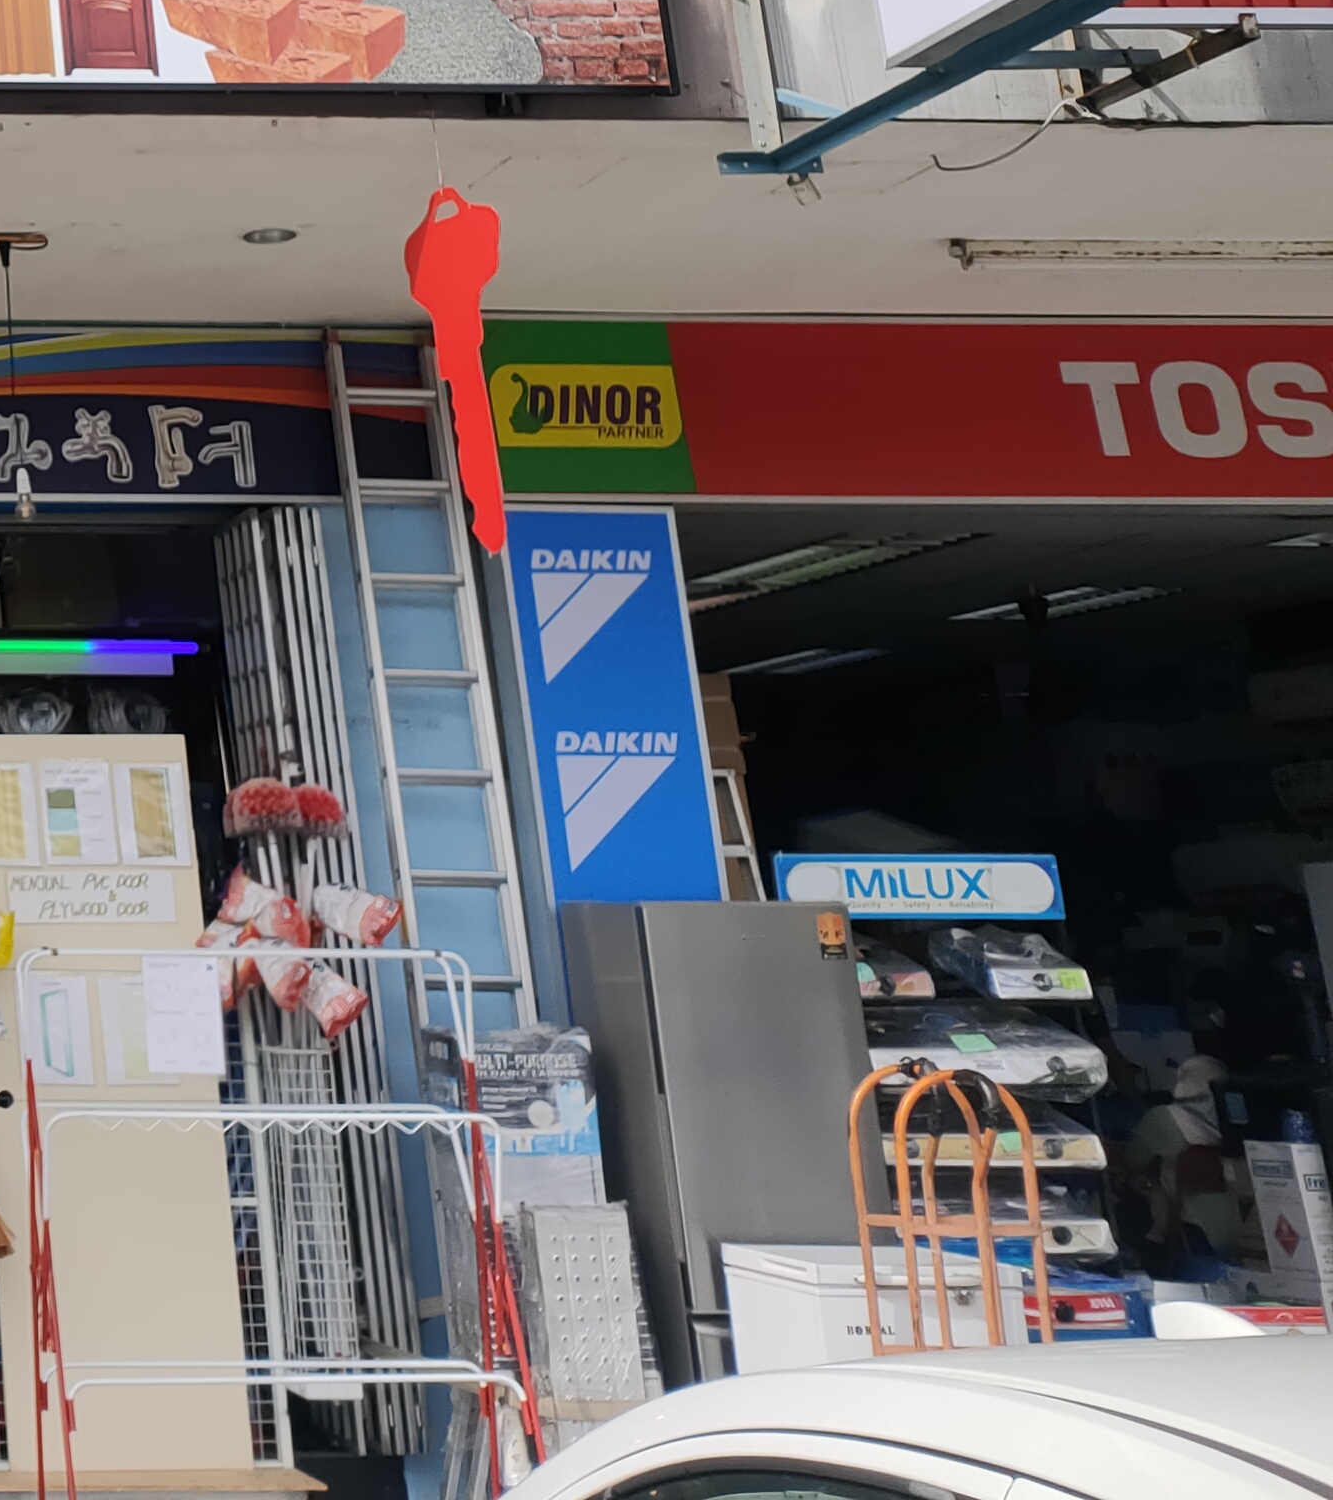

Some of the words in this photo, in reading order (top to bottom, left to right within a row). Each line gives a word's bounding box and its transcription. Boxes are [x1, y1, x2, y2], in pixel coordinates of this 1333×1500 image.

[529, 384, 662, 426] DINOR
[1059, 361, 1333, 459] TOS
[597, 426, 665, 440] PARTNER
[531, 549, 651, 571] DAIKIN
[555, 730, 678, 754] DAIKIN
[9, 875, 71, 891] MENJUAL
[82, 874, 110, 891] PVC
[116, 873, 149, 888] DOOR
[37, 901, 108, 920] PLYWOOD
[116, 902, 150, 917] DOOR
[901, 900, 931, 911] Safety
[948, 900, 995, 911] Reliability
[846, 1324, 896, 1336] BORAL
